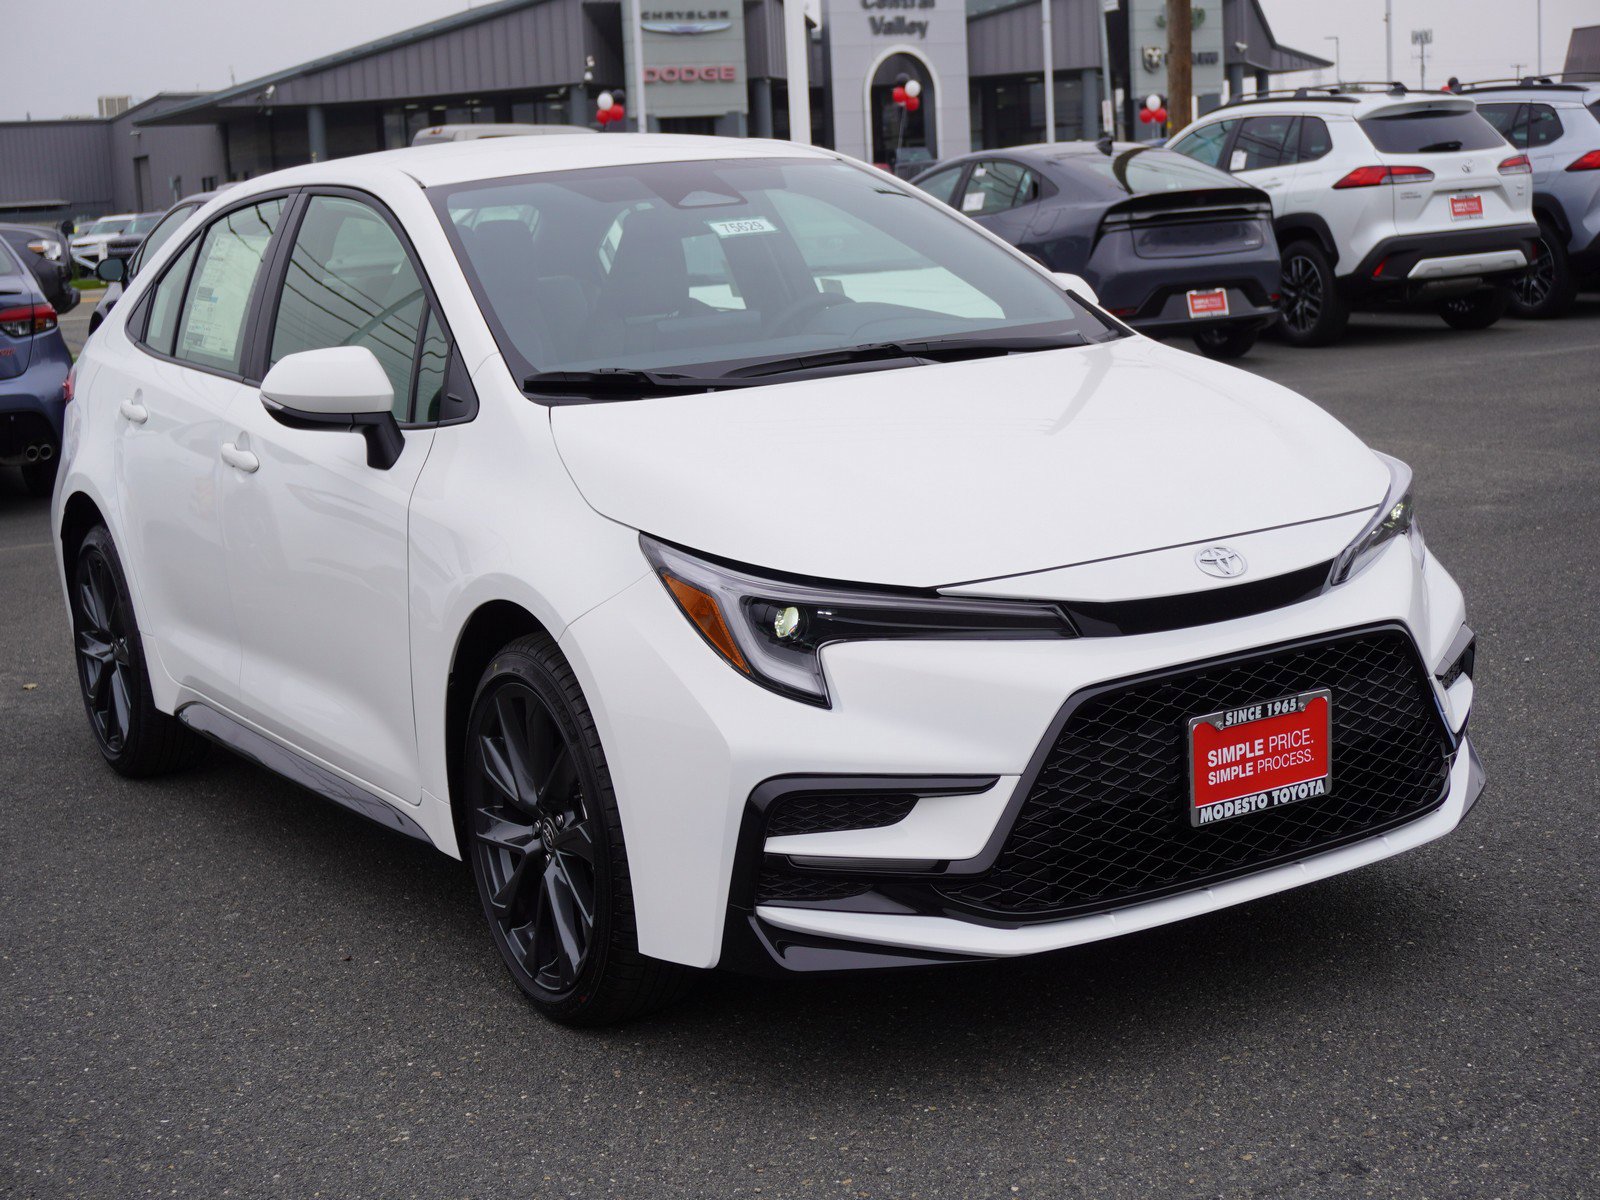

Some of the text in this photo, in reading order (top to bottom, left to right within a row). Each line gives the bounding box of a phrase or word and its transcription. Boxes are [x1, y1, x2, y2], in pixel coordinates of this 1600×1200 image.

[641, 10, 729, 20] CHRYSLER
[868, 15, 928, 39] Valley
[642, 65, 736, 84] DODGE
[719, 221, 765, 234] 75629
[1224, 698, 1297, 726] SINCE 1965
[1207, 728, 1314, 768] SIMPLE PRICE.
[1207, 748, 1315, 786] SIMPLE PROCESS.
[1200, 779, 1325, 824] MODESTO TOYOTA
